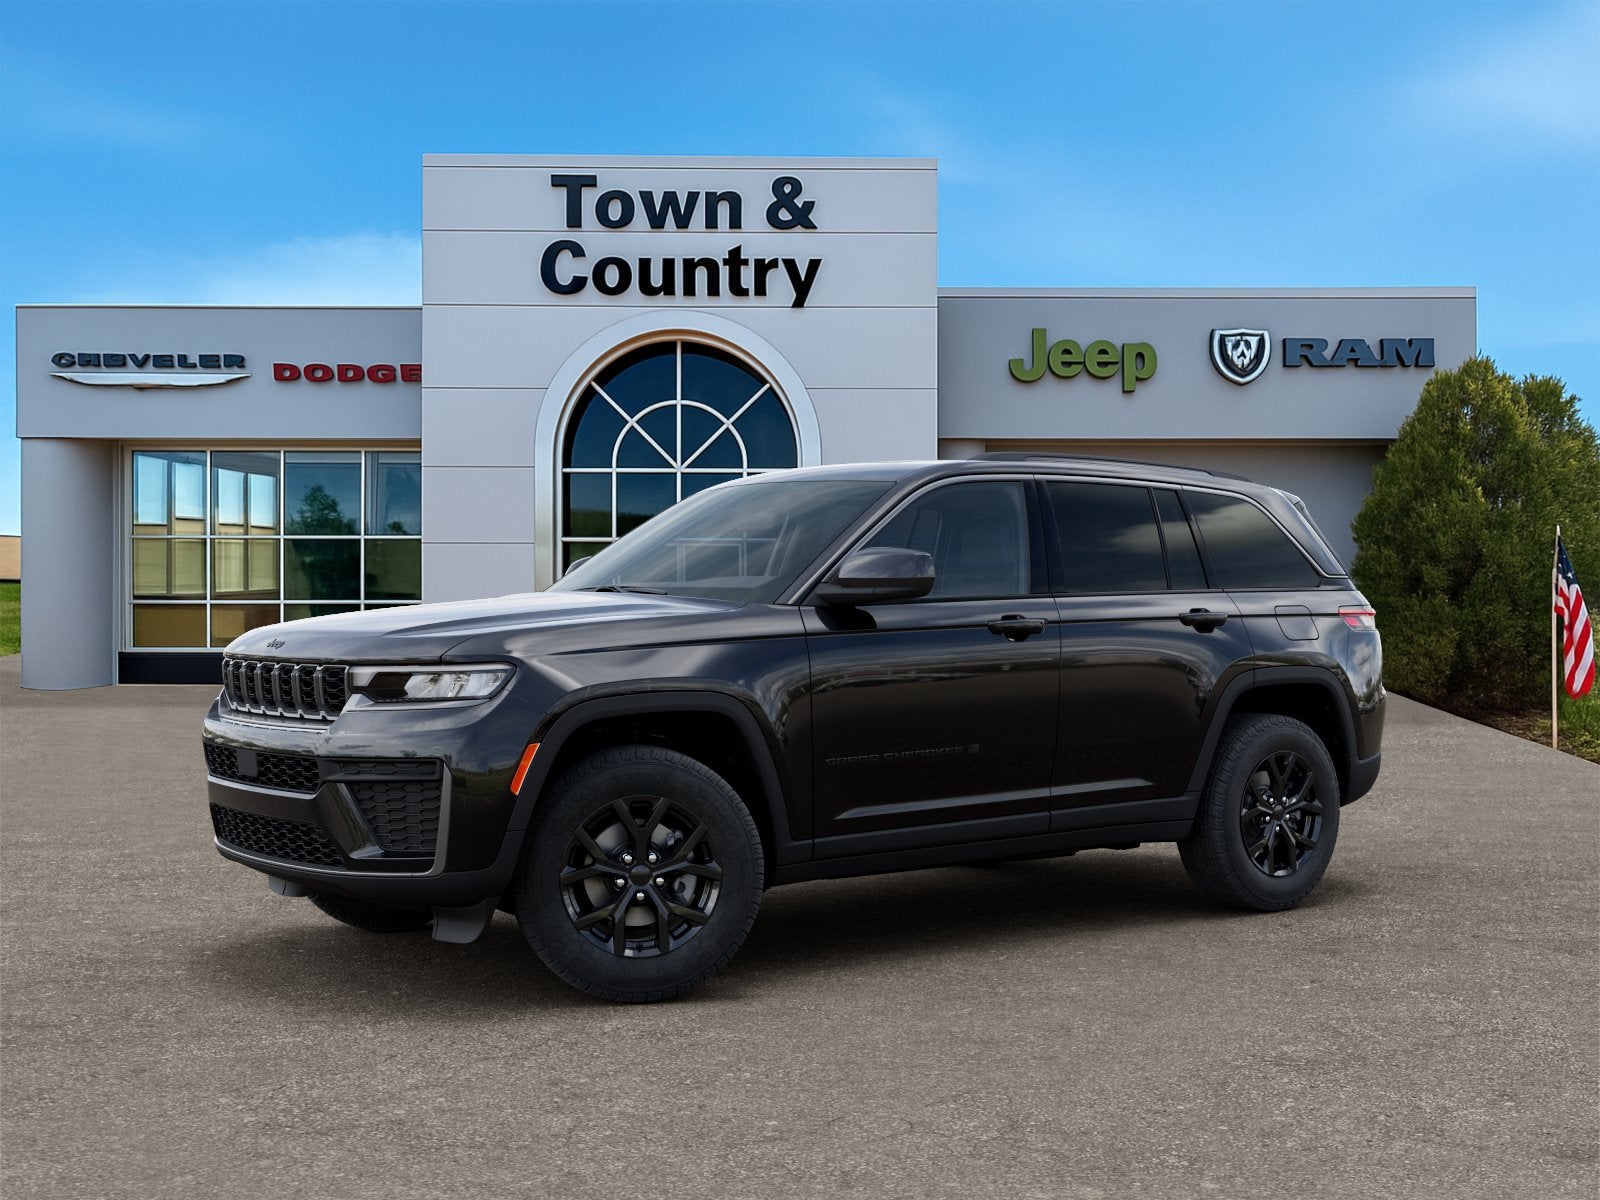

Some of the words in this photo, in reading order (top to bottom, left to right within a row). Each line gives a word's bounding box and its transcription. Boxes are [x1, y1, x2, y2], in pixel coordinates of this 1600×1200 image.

[550, 173, 743, 230] Town
[765, 175, 818, 230] &
[540, 239, 823, 309] Country
[272, 362, 422, 383] DODGE
[1008, 327, 1158, 393] Jeep
[1282, 337, 1436, 368] RAM
